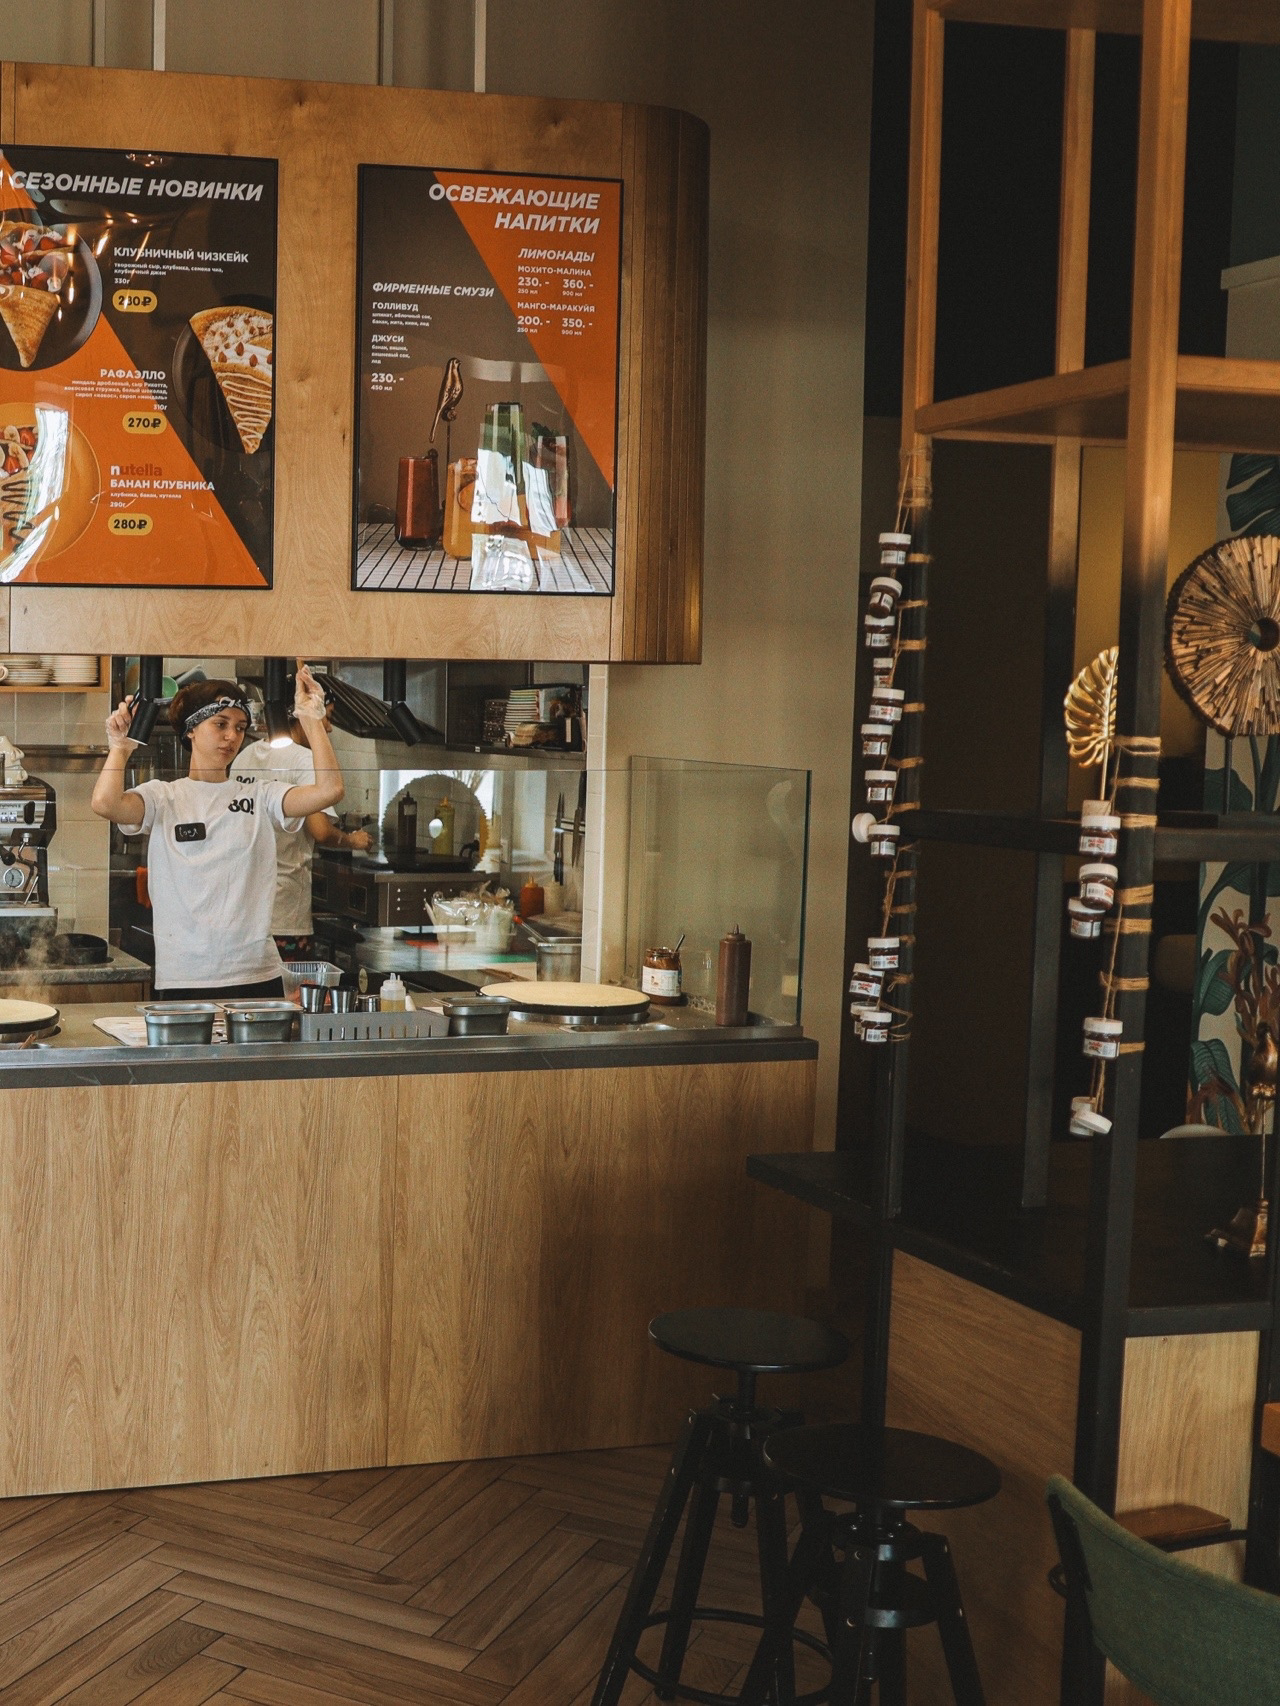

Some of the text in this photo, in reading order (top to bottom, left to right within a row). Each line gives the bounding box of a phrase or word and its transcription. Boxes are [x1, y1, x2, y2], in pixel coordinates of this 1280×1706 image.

[11, 170, 264, 202] СЕЗОННЫЕ НОВИНКИ
[428, 183, 601, 211] ОСВЕЖАЮЩИЕ
[494, 212, 601, 234] НАПИТКИ
[113, 246, 249, 263] КЛУБНИЧНЫЙ ЧИЗКЕЙК
[517, 247, 595, 263] ЛИМОНАДЫ
[517, 265, 592, 277] МОХИТО-МАЛИНА
[372, 281, 495, 298] ФИРМЕННЫЕ СМУЗИ
[372, 301, 419, 312] ГОЛЛИВУД
[517, 301, 595, 313] МАНГО-МАРАКУЙЯ
[371, 334, 404, 343] ДЖУСИ
[100, 368, 166, 380] РАФАЭЛЛО
[128, 417, 161, 429] 270₽
[110, 463, 163, 477] nutella
[110, 479, 215, 491] БАНАН КЛУБНИКА
[113, 518, 148, 530] 280₽
